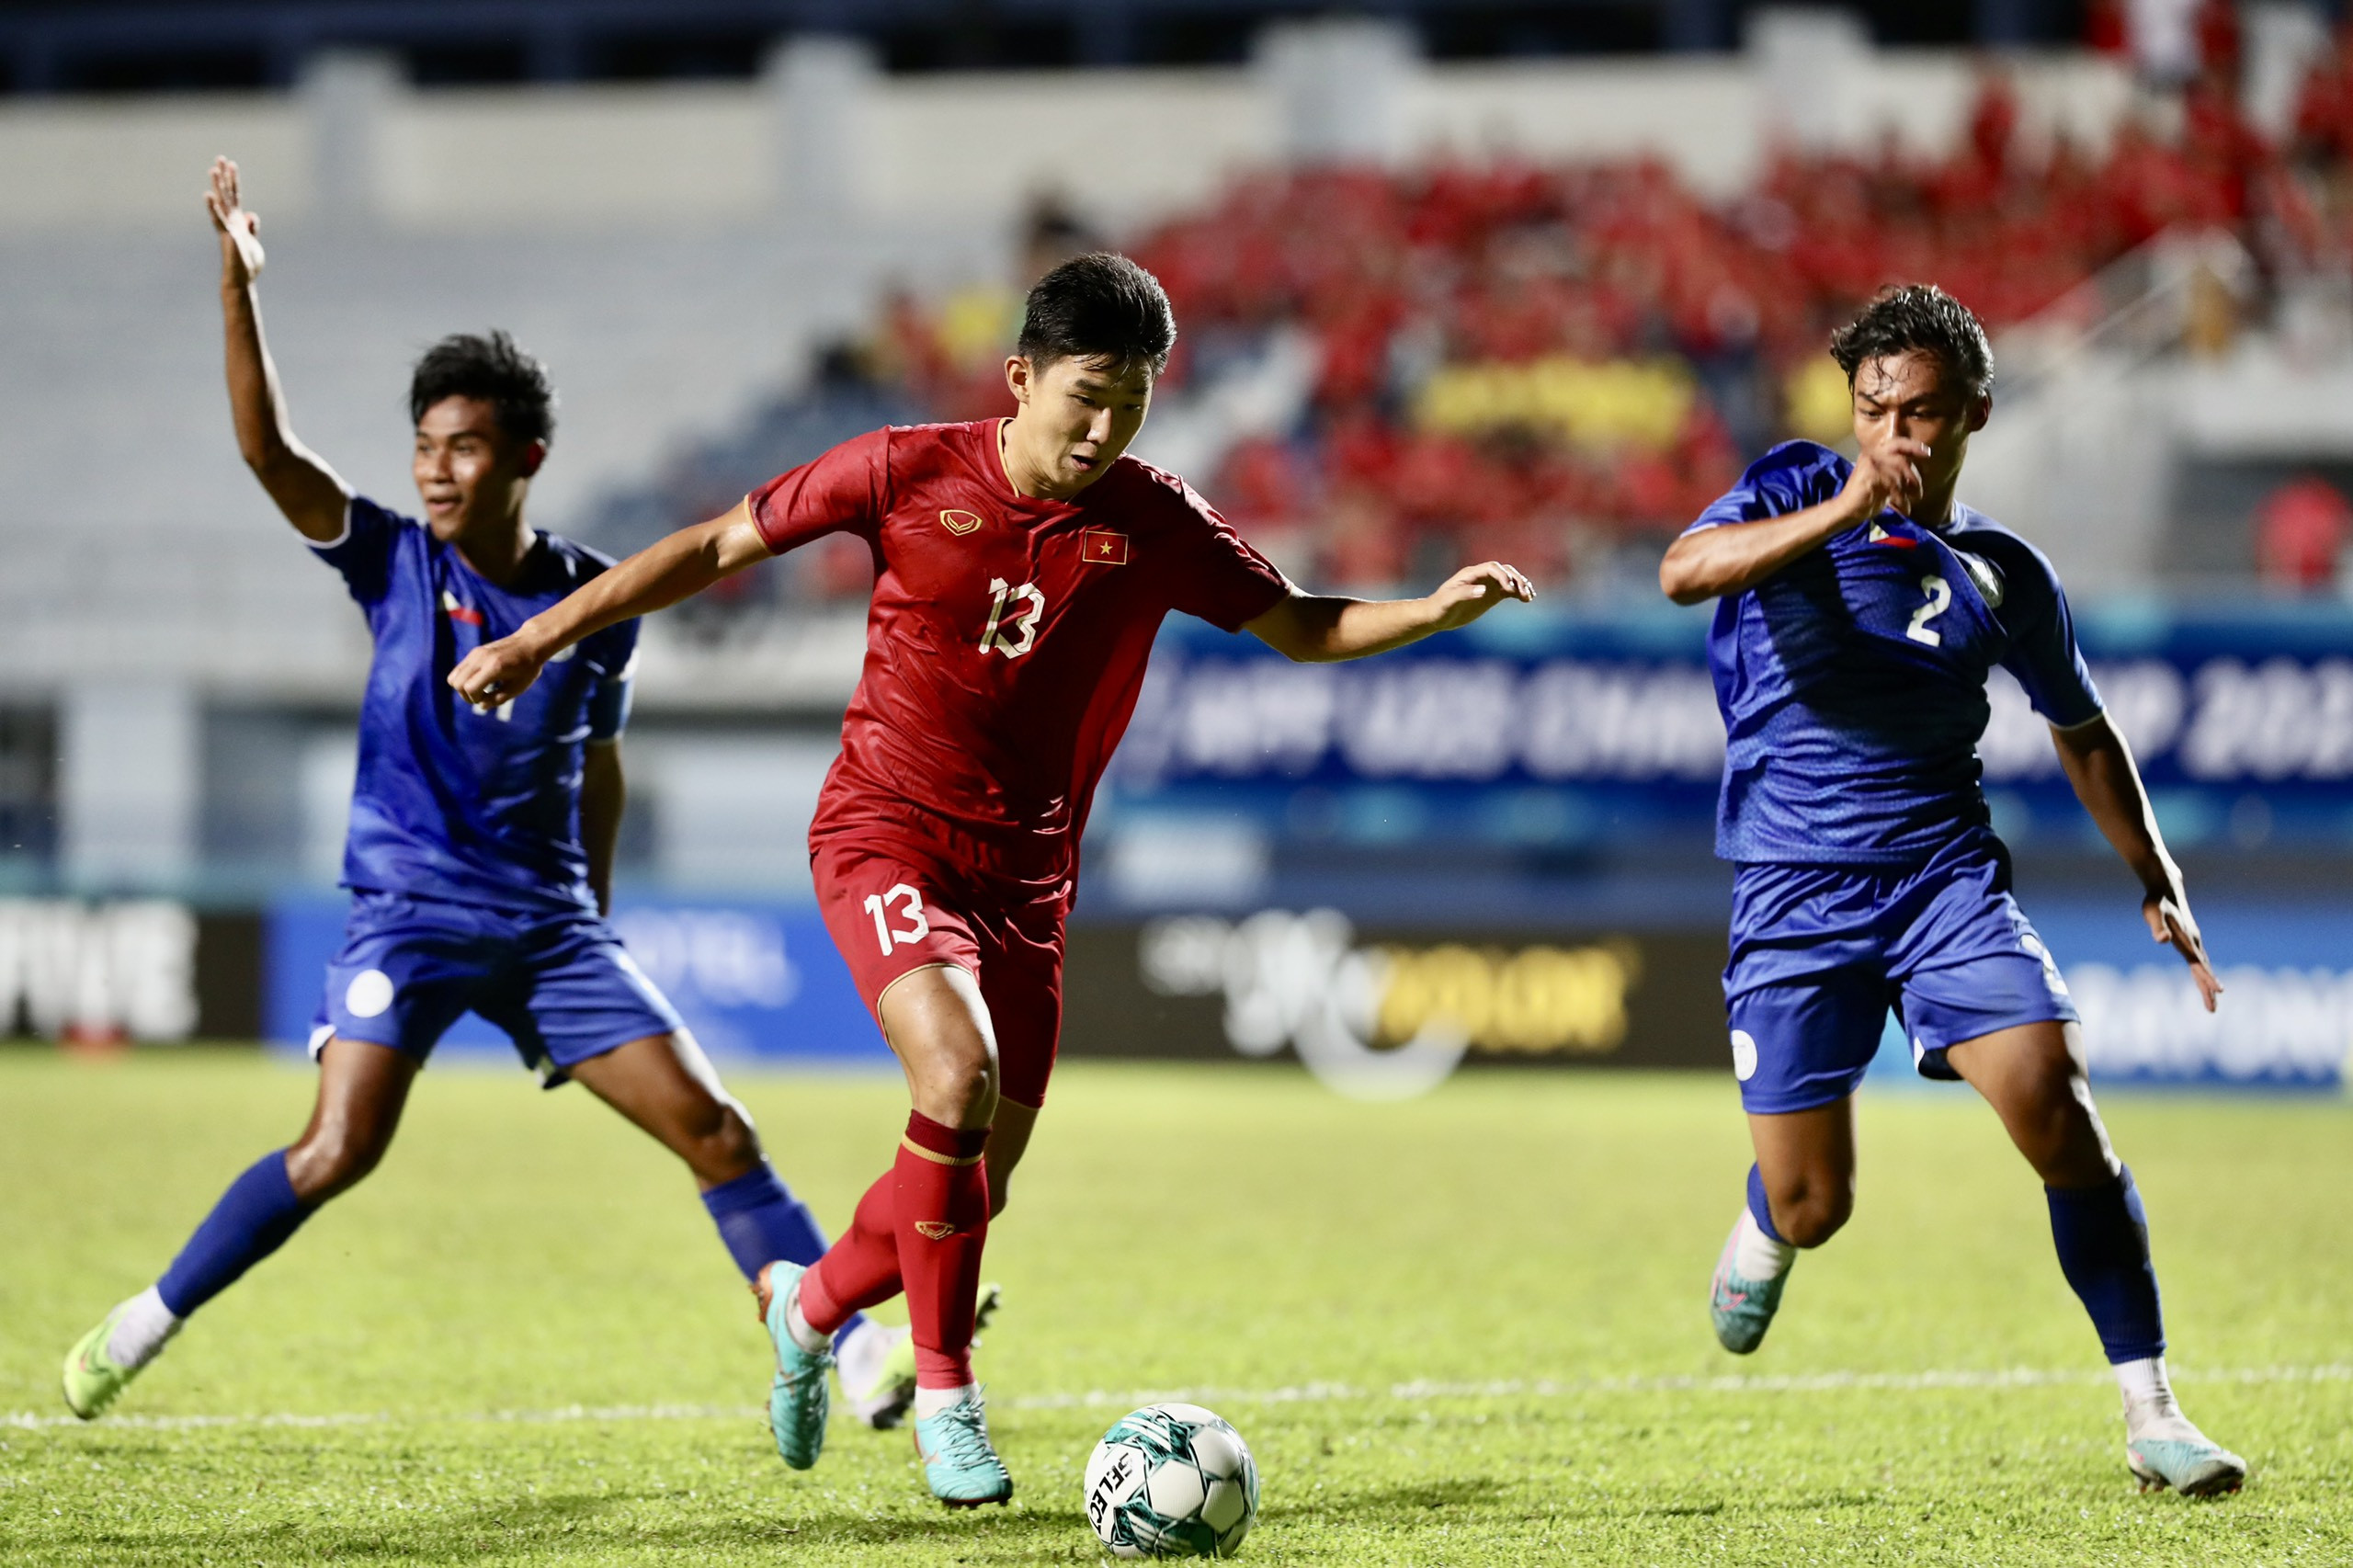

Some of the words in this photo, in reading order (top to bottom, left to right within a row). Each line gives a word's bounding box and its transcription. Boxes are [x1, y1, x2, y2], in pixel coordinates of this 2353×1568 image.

[978, 577, 1045, 659] 13
[1906, 574, 1951, 648] 2
[863, 882, 930, 956] 13
